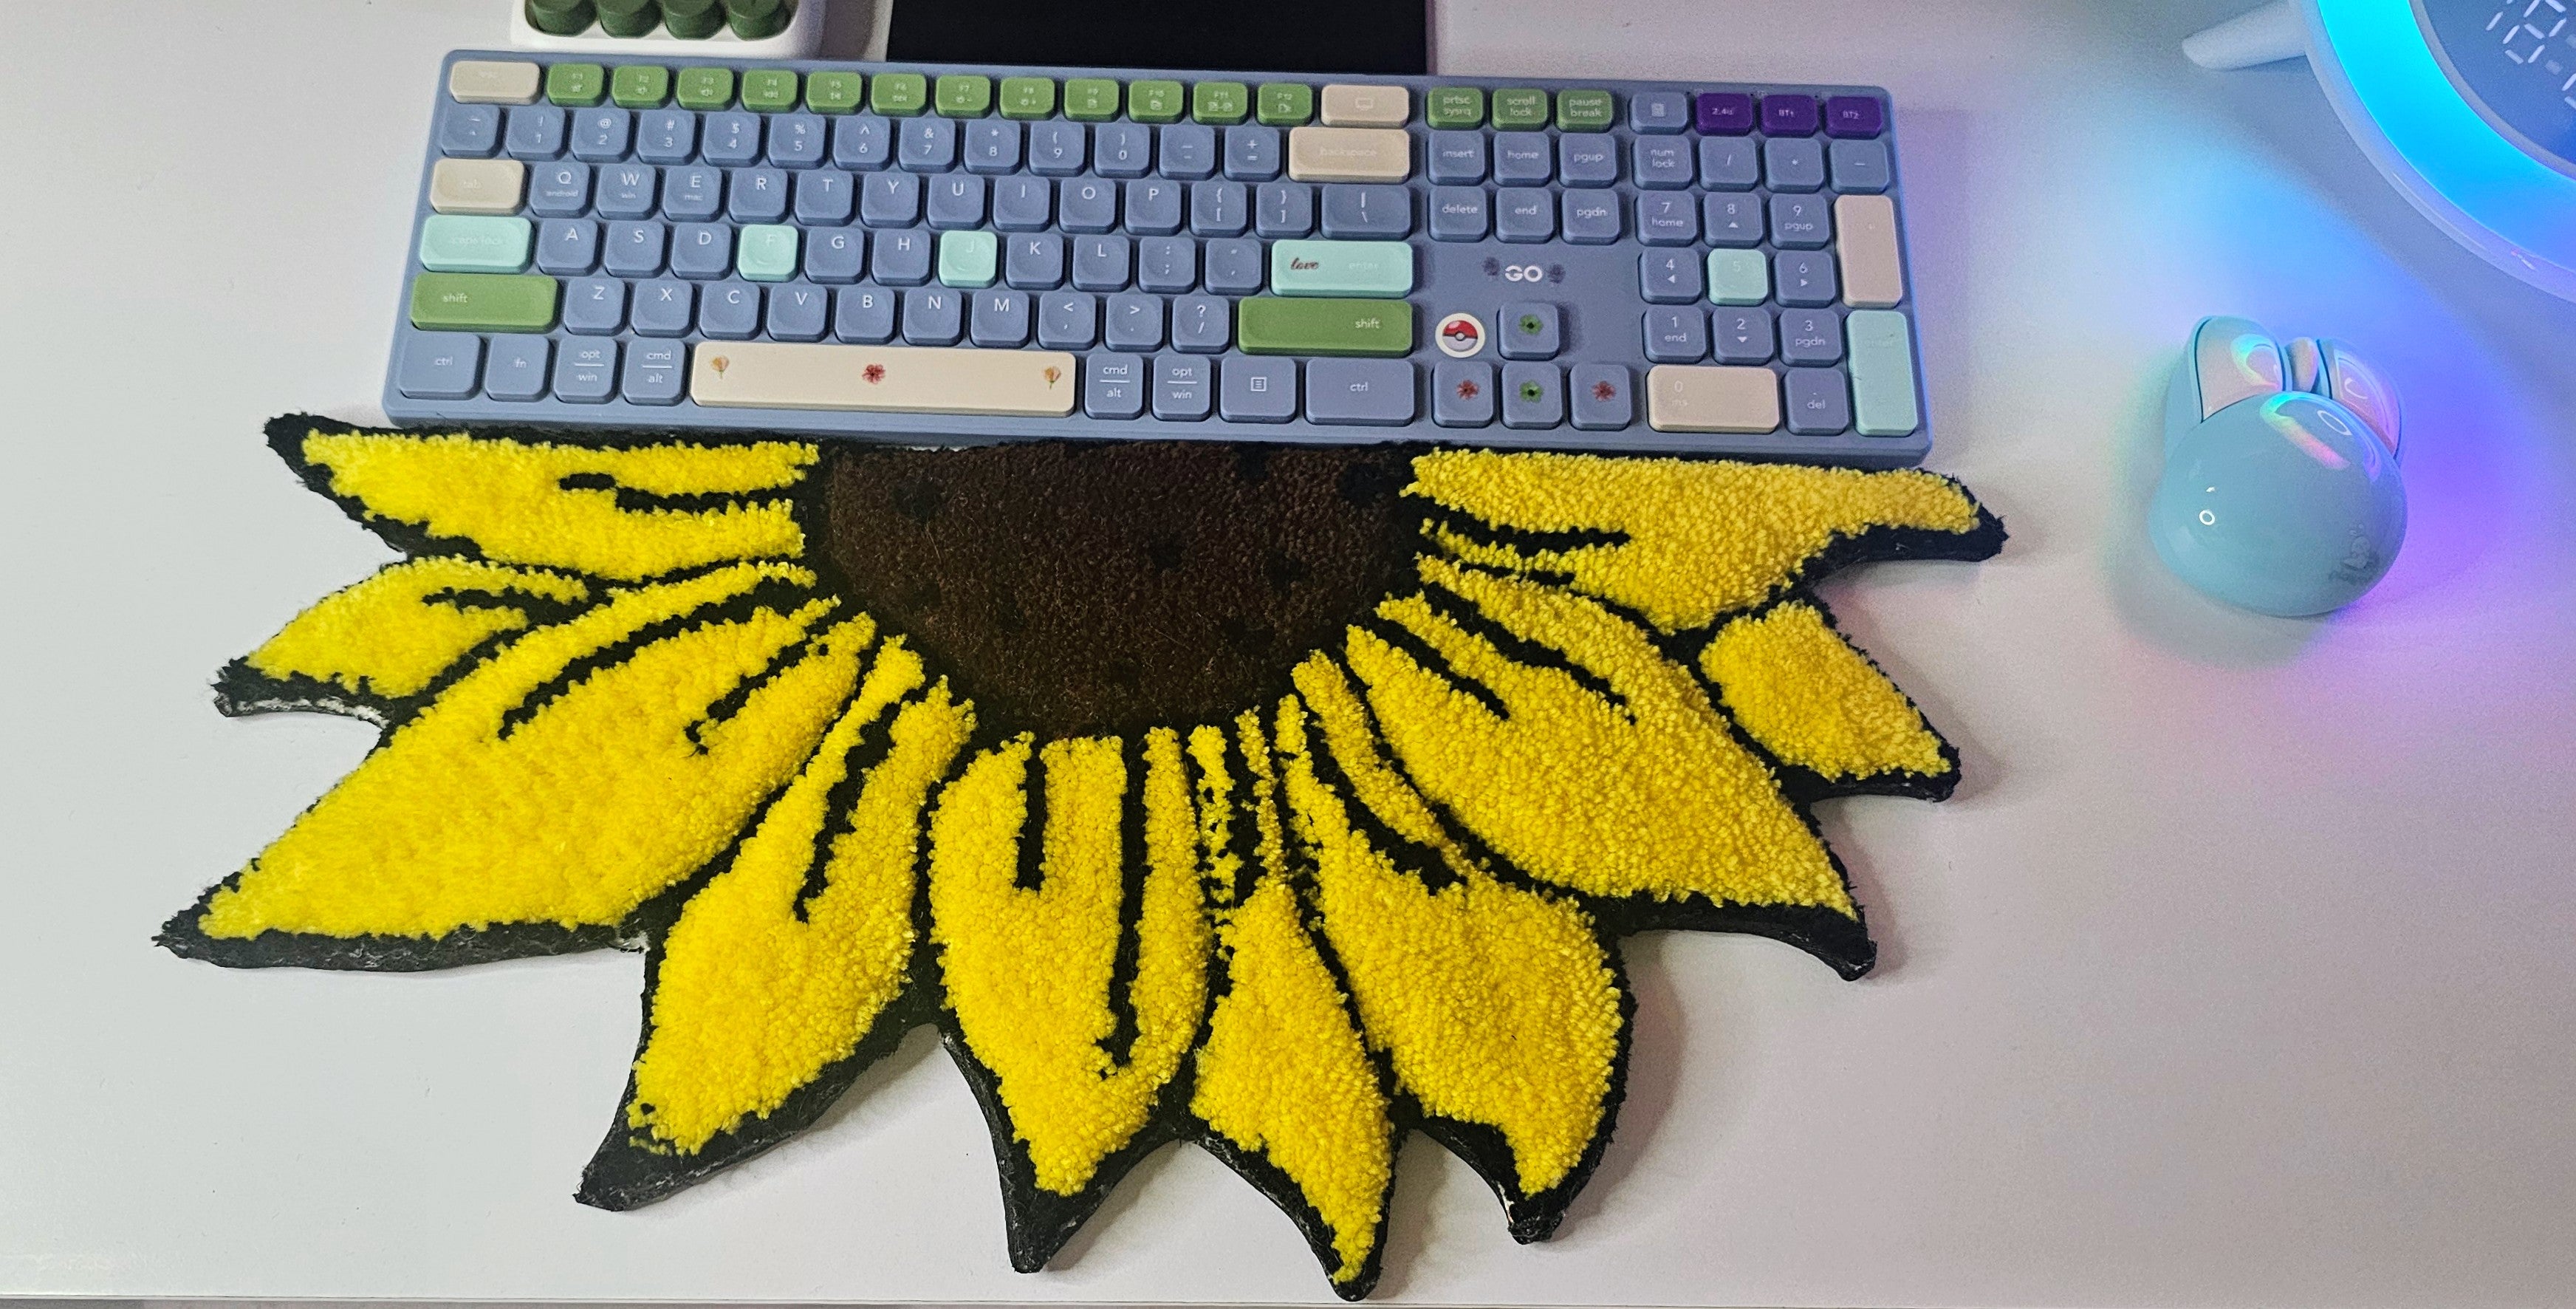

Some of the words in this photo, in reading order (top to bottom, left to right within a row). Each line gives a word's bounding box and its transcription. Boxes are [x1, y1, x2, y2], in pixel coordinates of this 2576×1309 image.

[1443, 95, 1472, 105] prtsc
[1507, 96, 1535, 106] scroll
[1569, 98, 1603, 107] pause
[1510, 107, 1532, 116] lock
[1570, 108, 1603, 117] break
[597, 118, 612, 129] @
[667, 120, 674, 130] #
[732, 123, 739, 134] $
[795, 124, 805, 134] %
[924, 127, 934, 138] &
[536, 134, 541, 143] 1
[597, 134, 607, 145] 2
[664, 137, 672, 147] 3
[729, 139, 736, 148] 4
[795, 140, 802, 151] 5
[859, 143, 868, 153] 6
[925, 144, 931, 154] 7
[989, 146, 997, 156] 8
[1054, 148, 1062, 158] 9
[1119, 150, 1127, 160] 0
[1507, 150, 1539, 159] home
[1574, 154, 1603, 163] pgup
[1652, 158, 1675, 168] lock
[557, 171, 571, 184] Q
[621, 173, 640, 185] W
[691, 175, 701, 188] E
[756, 177, 767, 190] R
[823, 179, 833, 191] T
[888, 180, 899, 194] Y
[953, 182, 964, 196] U
[1082, 187, 1095, 199] O
[1149, 188, 1159, 200] P
[1442, 204, 1478, 213] delete
[1515, 205, 1538, 215] end
[1577, 207, 1607, 219] pgdn
[1662, 202, 1671, 213] 7
[1727, 204, 1735, 214] 8
[1793, 205, 1801, 216] 9
[1652, 216, 1683, 226] home
[1785, 223, 1813, 231] pgup
[565, 228, 578, 240] A
[634, 230, 643, 242] S
[699, 231, 711, 245] D
[832, 235, 844, 249] G
[898, 238, 910, 250] H
[966, 239, 974, 253] J
[1030, 242, 1041, 254] K
[1098, 244, 1106, 256] L
[1291, 257, 1318, 270] love
[1666, 259, 1674, 270] 4
[1799, 263, 1808, 273] 6
[1505, 265, 1543, 281] GO
[443, 293, 467, 303] shift
[593, 286, 605, 299] Z
[661, 288, 672, 301] X
[727, 290, 739, 304] C
[795, 292, 807, 305] V
[863, 295, 872, 308] B
[928, 296, 941, 309] N
[995, 298, 1009, 312] M
[1063, 302, 1073, 311] <
[1130, 306, 1140, 314] >
[1197, 305, 1206, 317] ?
[1355, 318, 1379, 329] shift
[1672, 316, 1677, 327] 1
[1737, 318, 1745, 329] 2
[1805, 320, 1813, 331] 3
[1665, 332, 1687, 342] end
[1795, 336, 1826, 347] pgdn
[580, 350, 600, 360] opt
[646, 350, 671, 360] cmd
[435, 357, 453, 365] ctrl
[1103, 364, 1128, 375] cmd
[1172, 368, 1192, 377] opt
[648, 373, 662, 383] alt
[1350, 382, 1368, 392] ctrl
[1674, 380, 1683, 392] 0
[1107, 388, 1121, 397] alt
[1172, 390, 1192, 398] win
[1807, 400, 1826, 409] del
